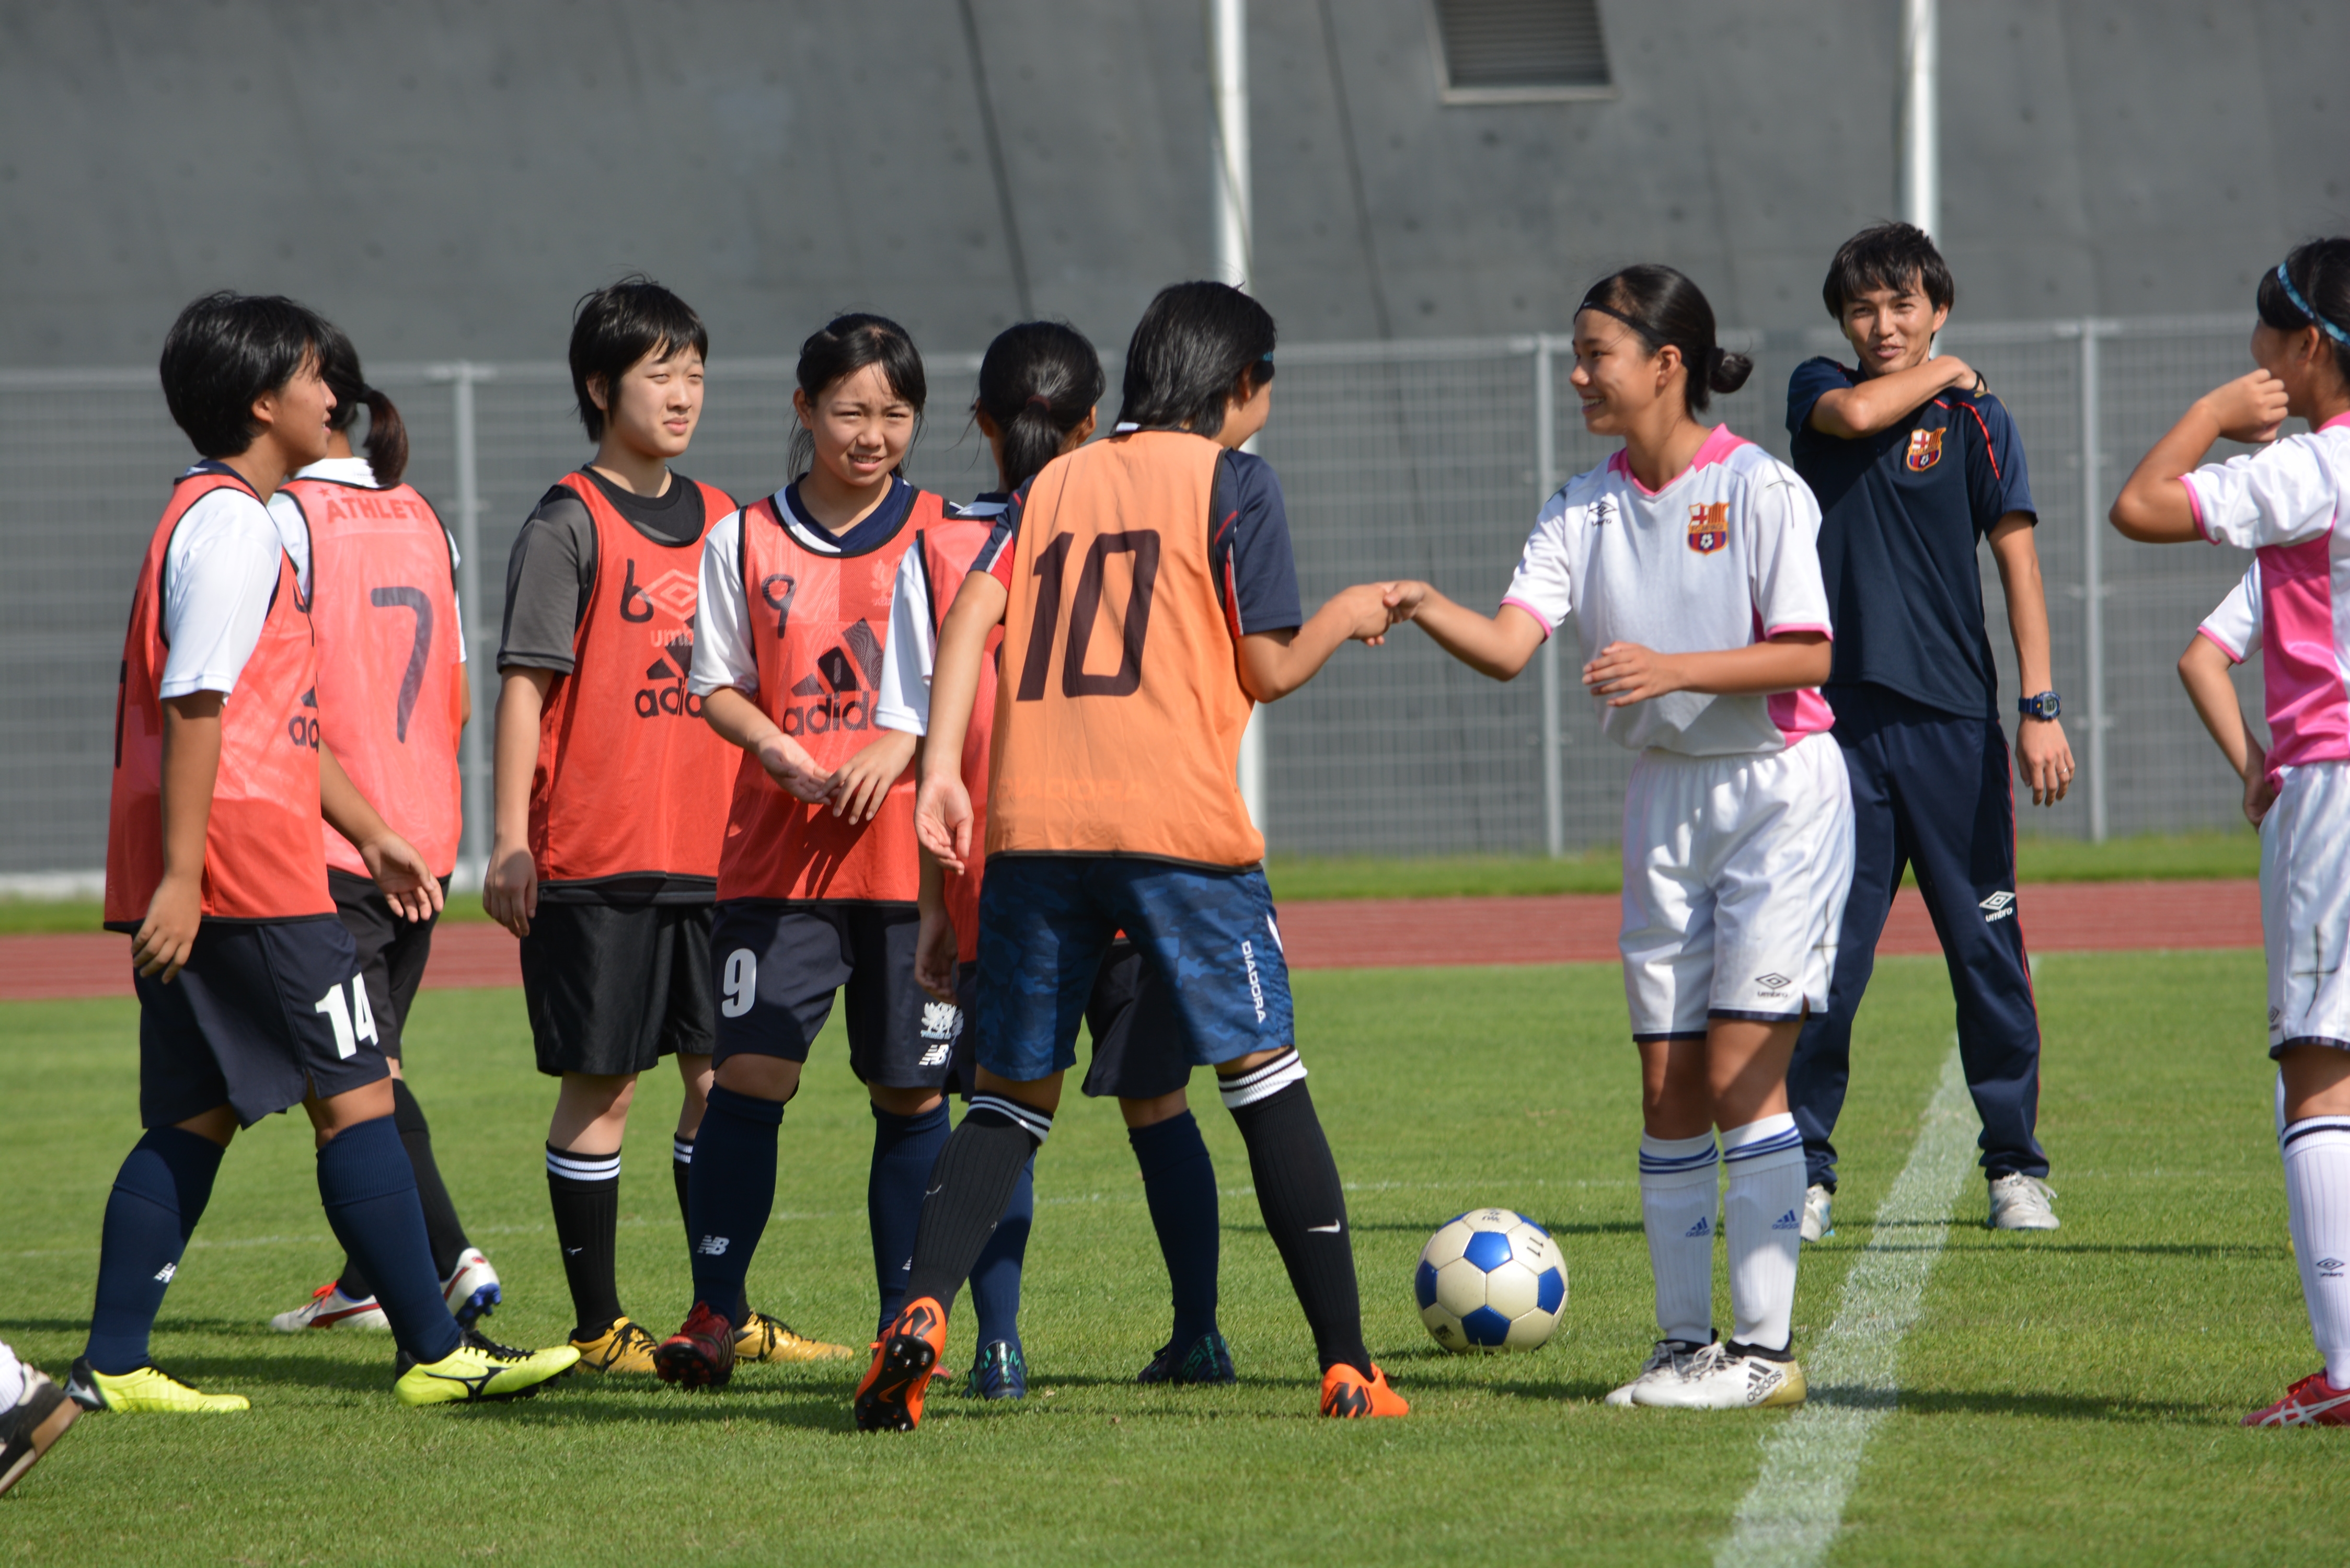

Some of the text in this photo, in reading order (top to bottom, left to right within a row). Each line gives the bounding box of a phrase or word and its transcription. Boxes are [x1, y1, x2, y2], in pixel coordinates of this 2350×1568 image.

[620, 558, 654, 622] 6
[762, 574, 797, 639] 9
[1016, 529, 1160, 701] 10
[371, 586, 433, 743] 7
[1985, 907, 2013, 923] umbro
[315, 972, 379, 1060] 14
[722, 948, 757, 1018] 9
[1241, 940, 1266, 1024] DIADORA
[1747, 1370, 1782, 1402] adidas
